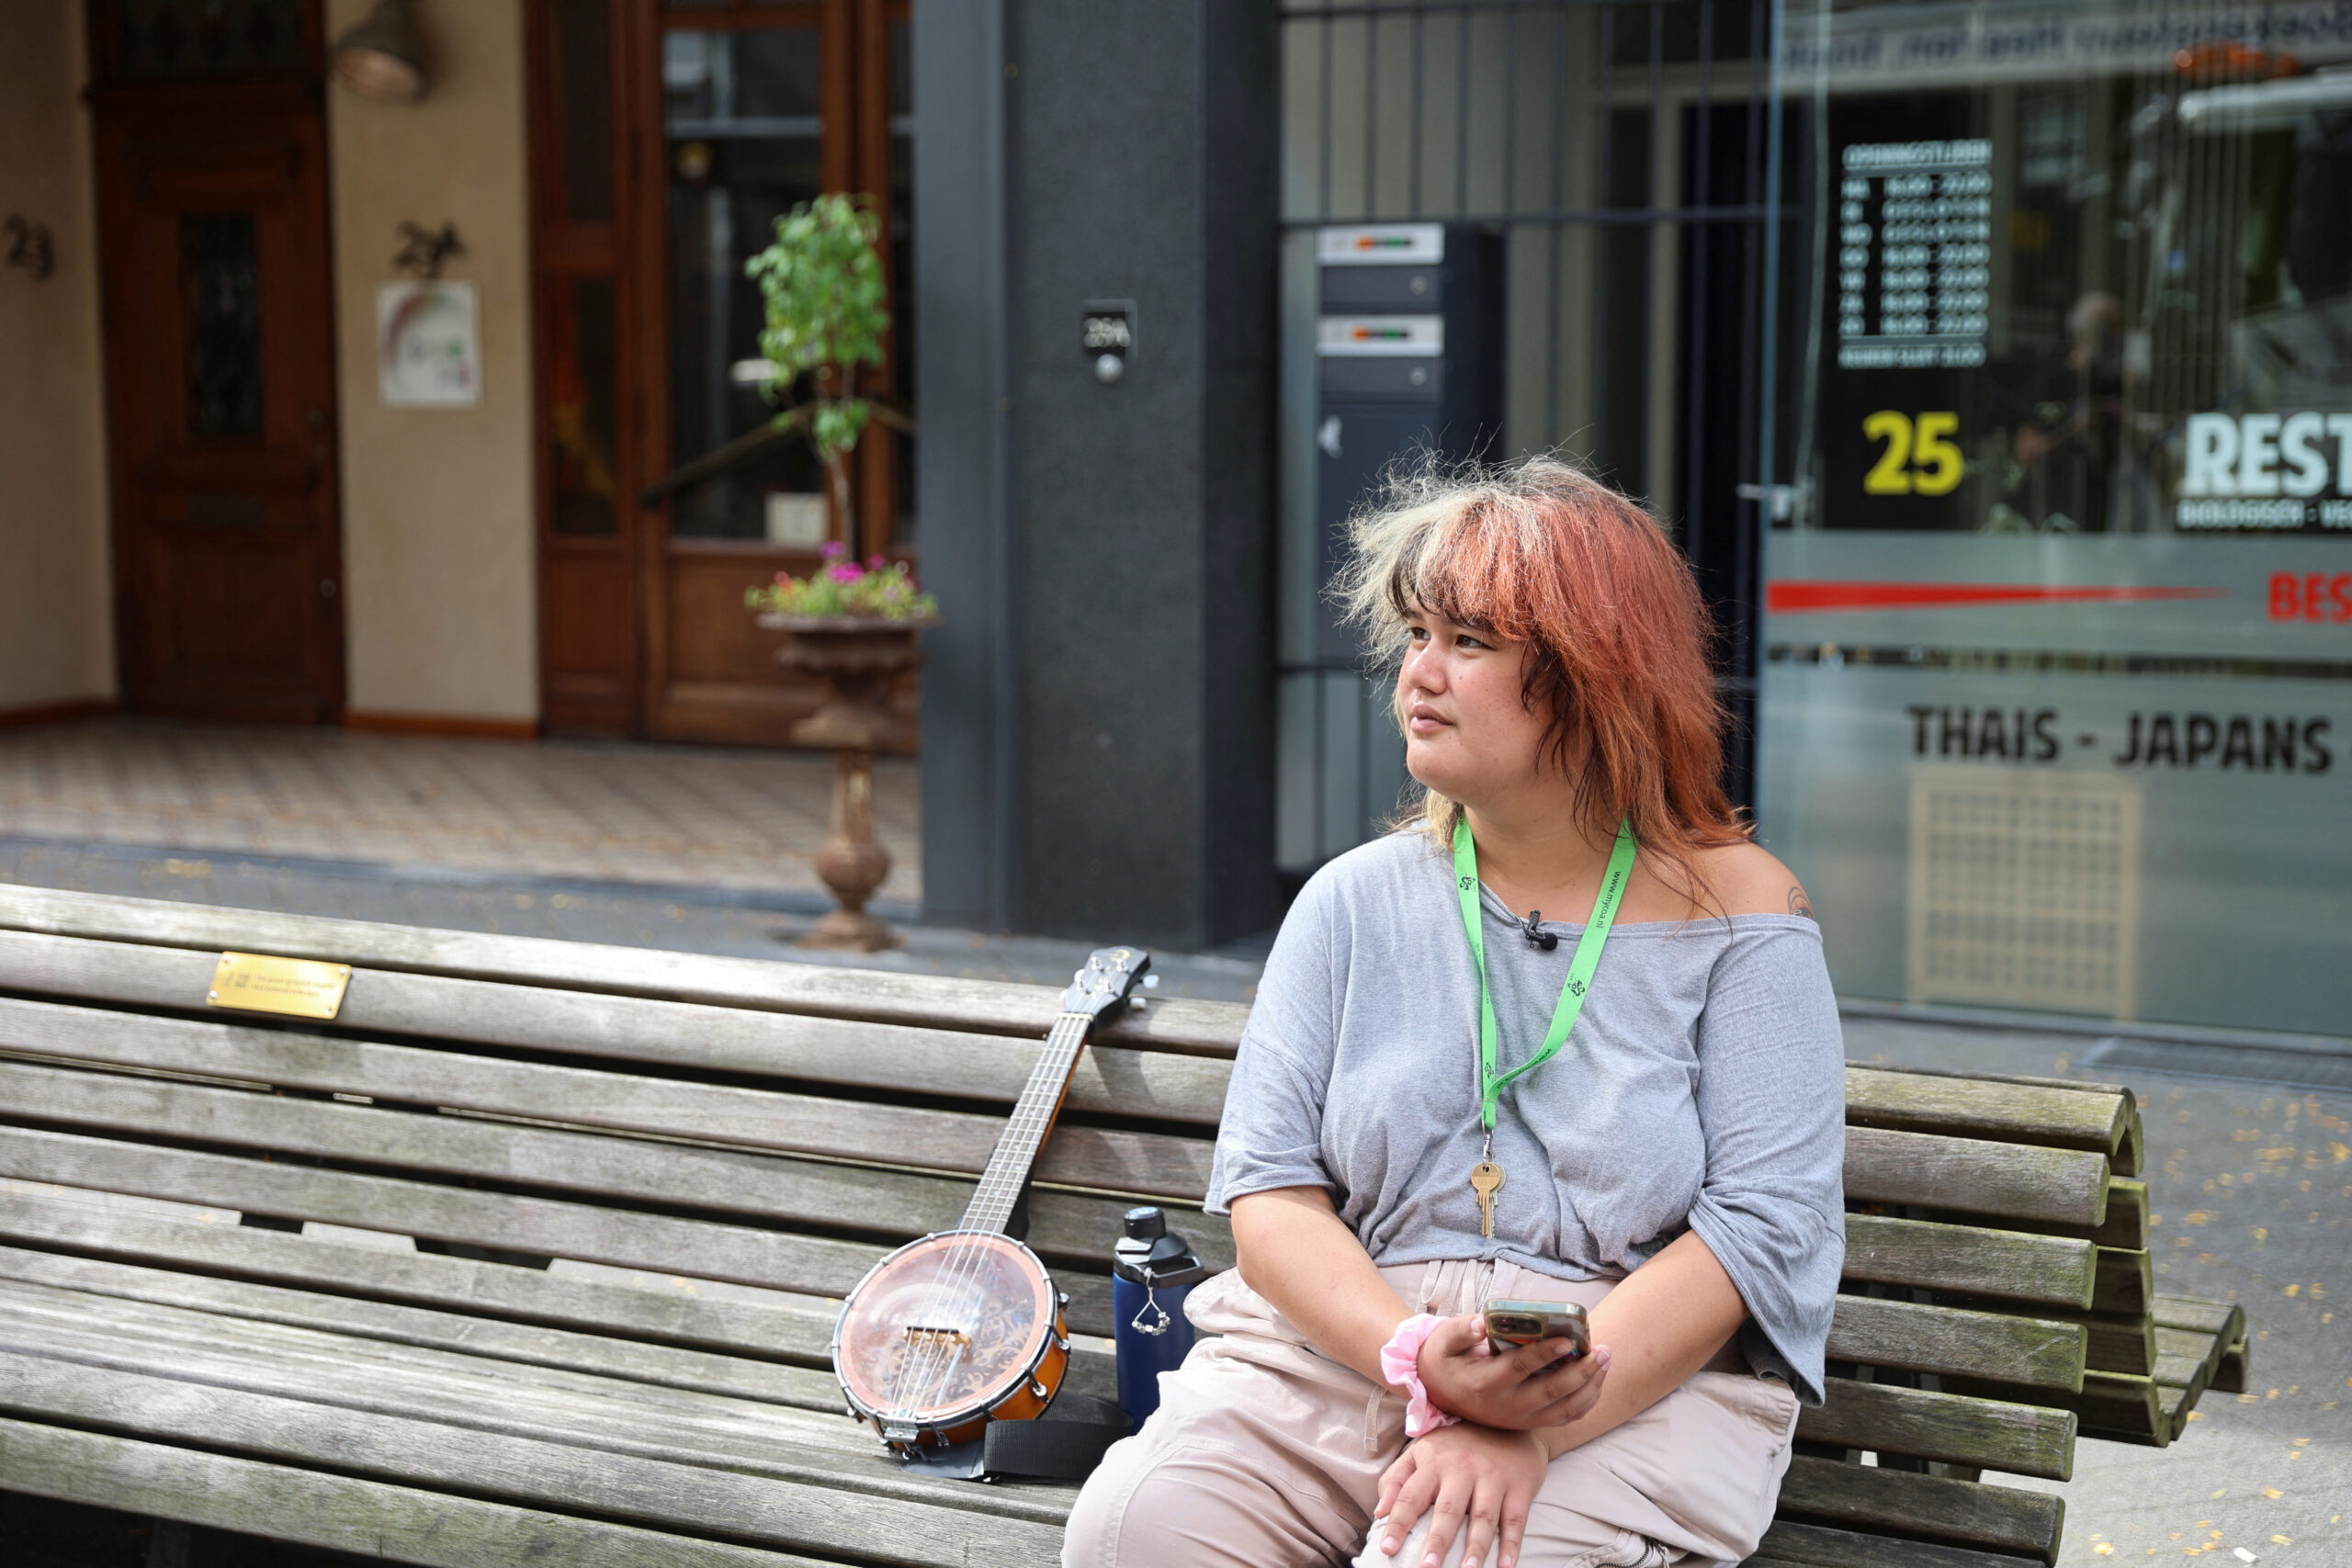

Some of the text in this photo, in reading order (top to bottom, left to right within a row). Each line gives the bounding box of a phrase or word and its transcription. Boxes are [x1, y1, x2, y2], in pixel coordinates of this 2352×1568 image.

[1863, 412, 1963, 494] 25
[2185, 412, 2352, 497] REST
[2268, 571, 2352, 624] BES
[1908, 705, 2058, 761] THAIS
[2115, 712, 2334, 774] JAPANS
[1596, 871, 1621, 928] www.mycoa.nl
